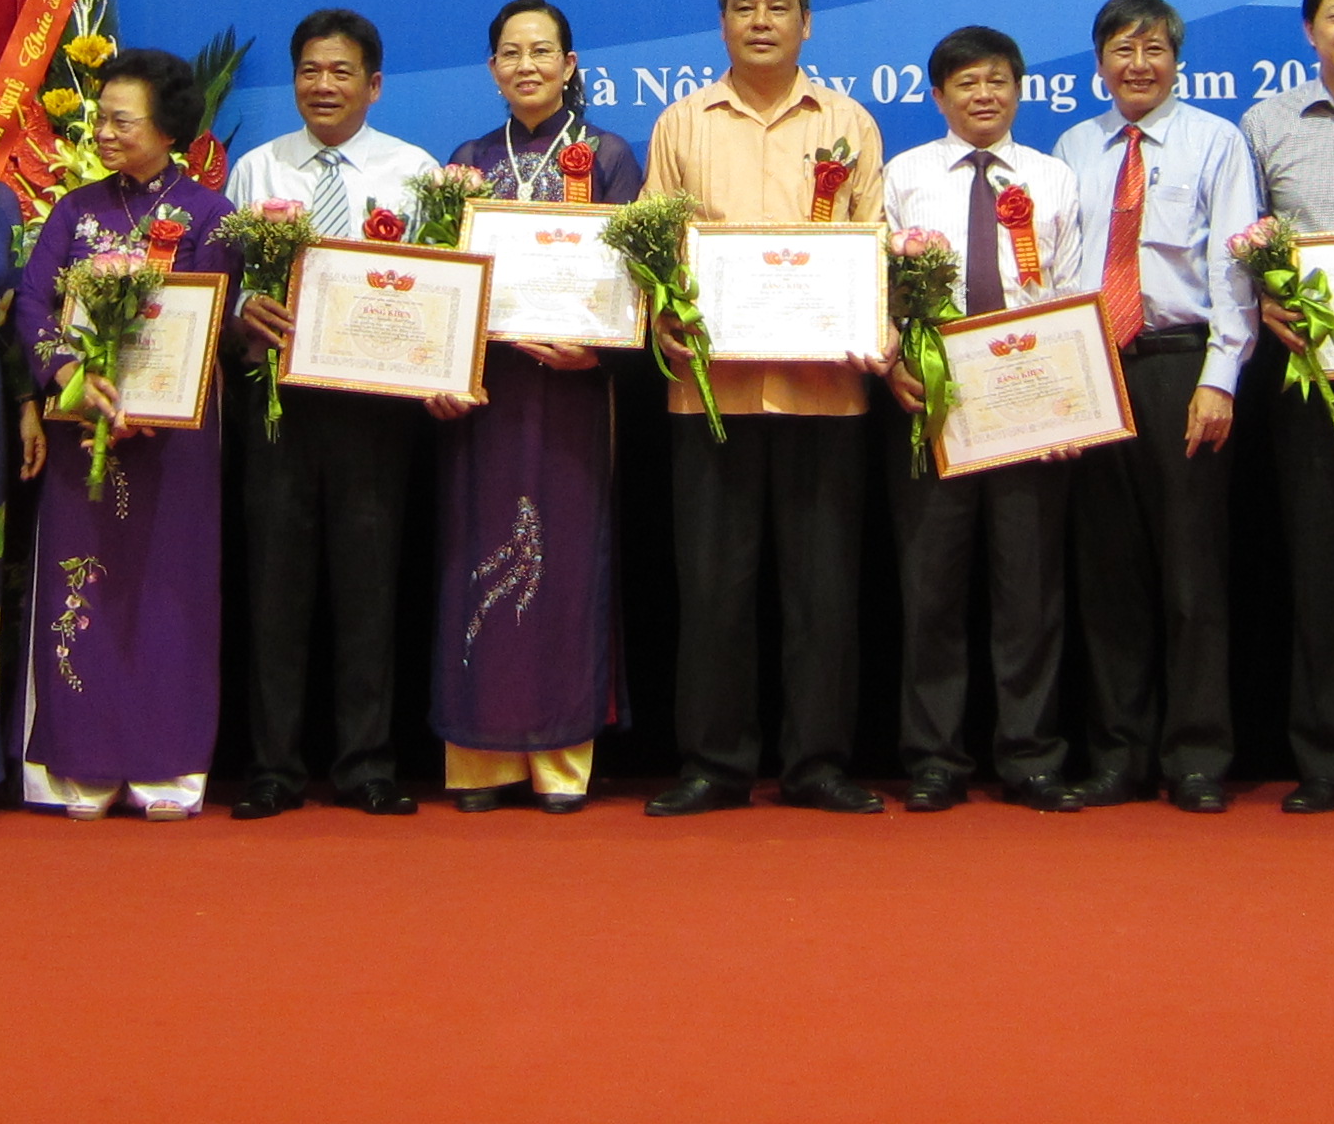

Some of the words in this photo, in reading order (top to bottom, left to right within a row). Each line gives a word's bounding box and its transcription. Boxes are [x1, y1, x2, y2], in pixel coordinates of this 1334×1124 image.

[19, 12, 54, 67] Chúc
[580, 66, 618, 106] à
[872, 64, 925, 104] 02
